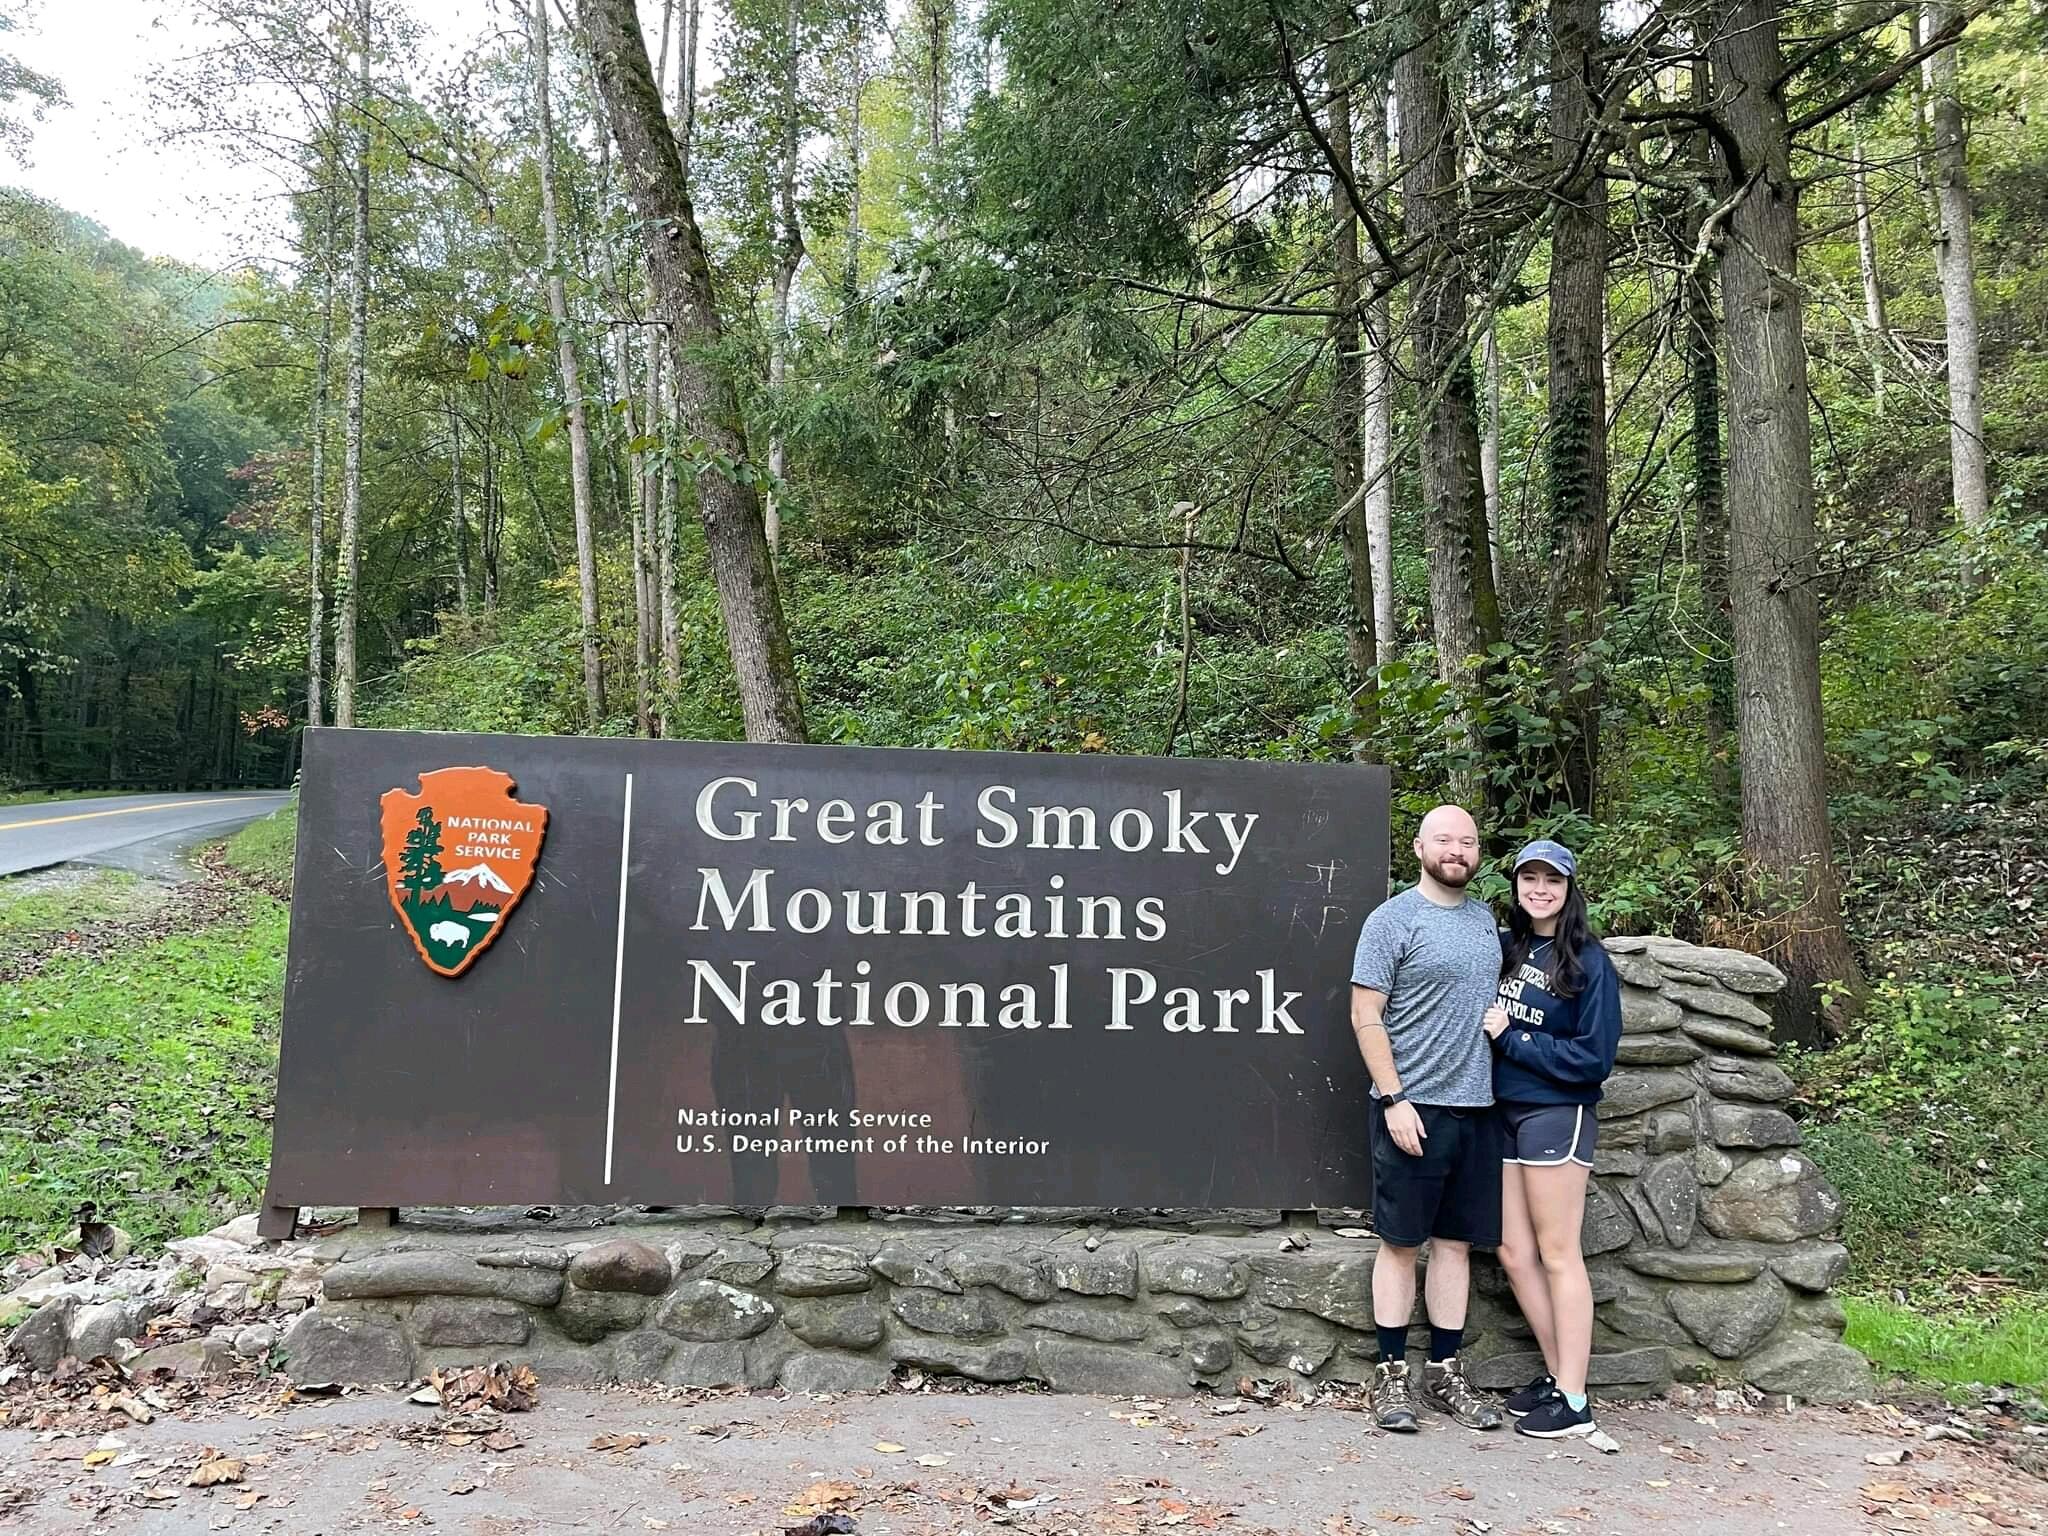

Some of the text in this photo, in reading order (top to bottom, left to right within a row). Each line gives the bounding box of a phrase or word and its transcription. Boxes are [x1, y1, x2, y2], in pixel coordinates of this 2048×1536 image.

[447, 816, 534, 833] NATIONAL
[695, 776, 1260, 876] Great Smoky
[467, 831, 512, 845] PARK
[455, 844, 521, 860] SERVICE
[688, 867, 1168, 942] Mountains
[683, 959, 1306, 1035] National Park
[677, 1107, 932, 1128] National Park Service
[676, 1134, 1050, 1158] U.S. Department of the Interior
